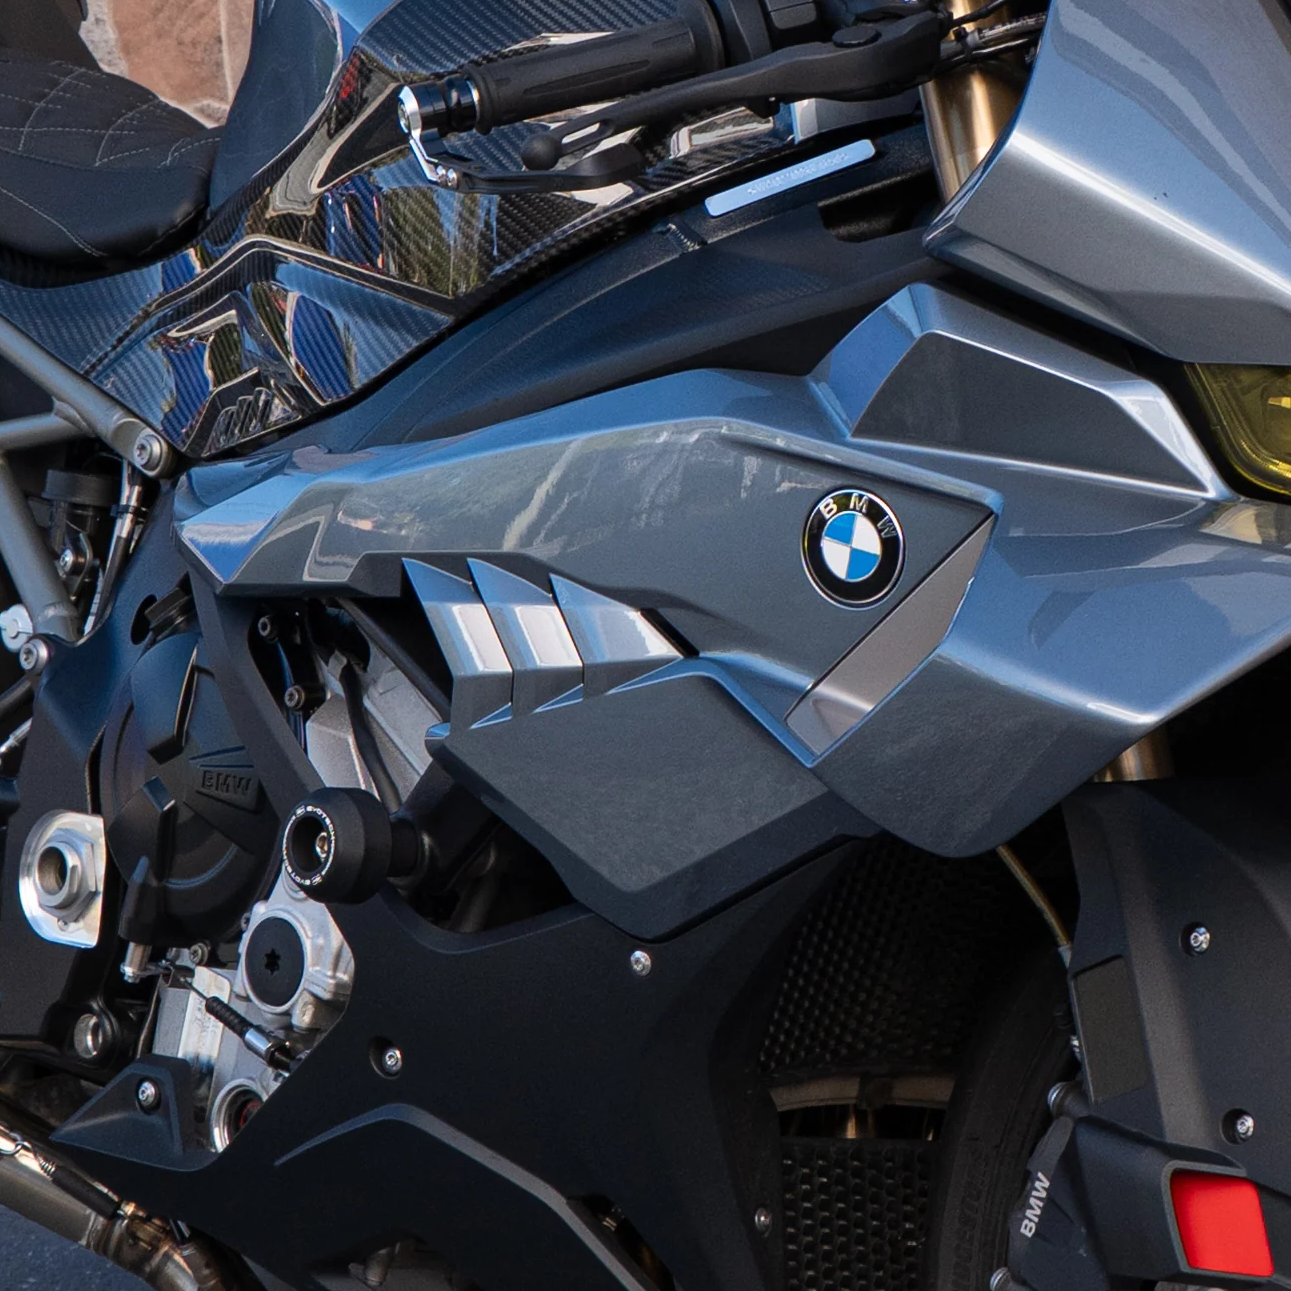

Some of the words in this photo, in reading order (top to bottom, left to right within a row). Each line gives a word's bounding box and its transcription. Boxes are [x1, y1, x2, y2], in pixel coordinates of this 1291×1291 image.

[819, 492, 897, 539] BMW
[201, 770, 252, 796] BMW
[1020, 1171, 1051, 1238] BMW
